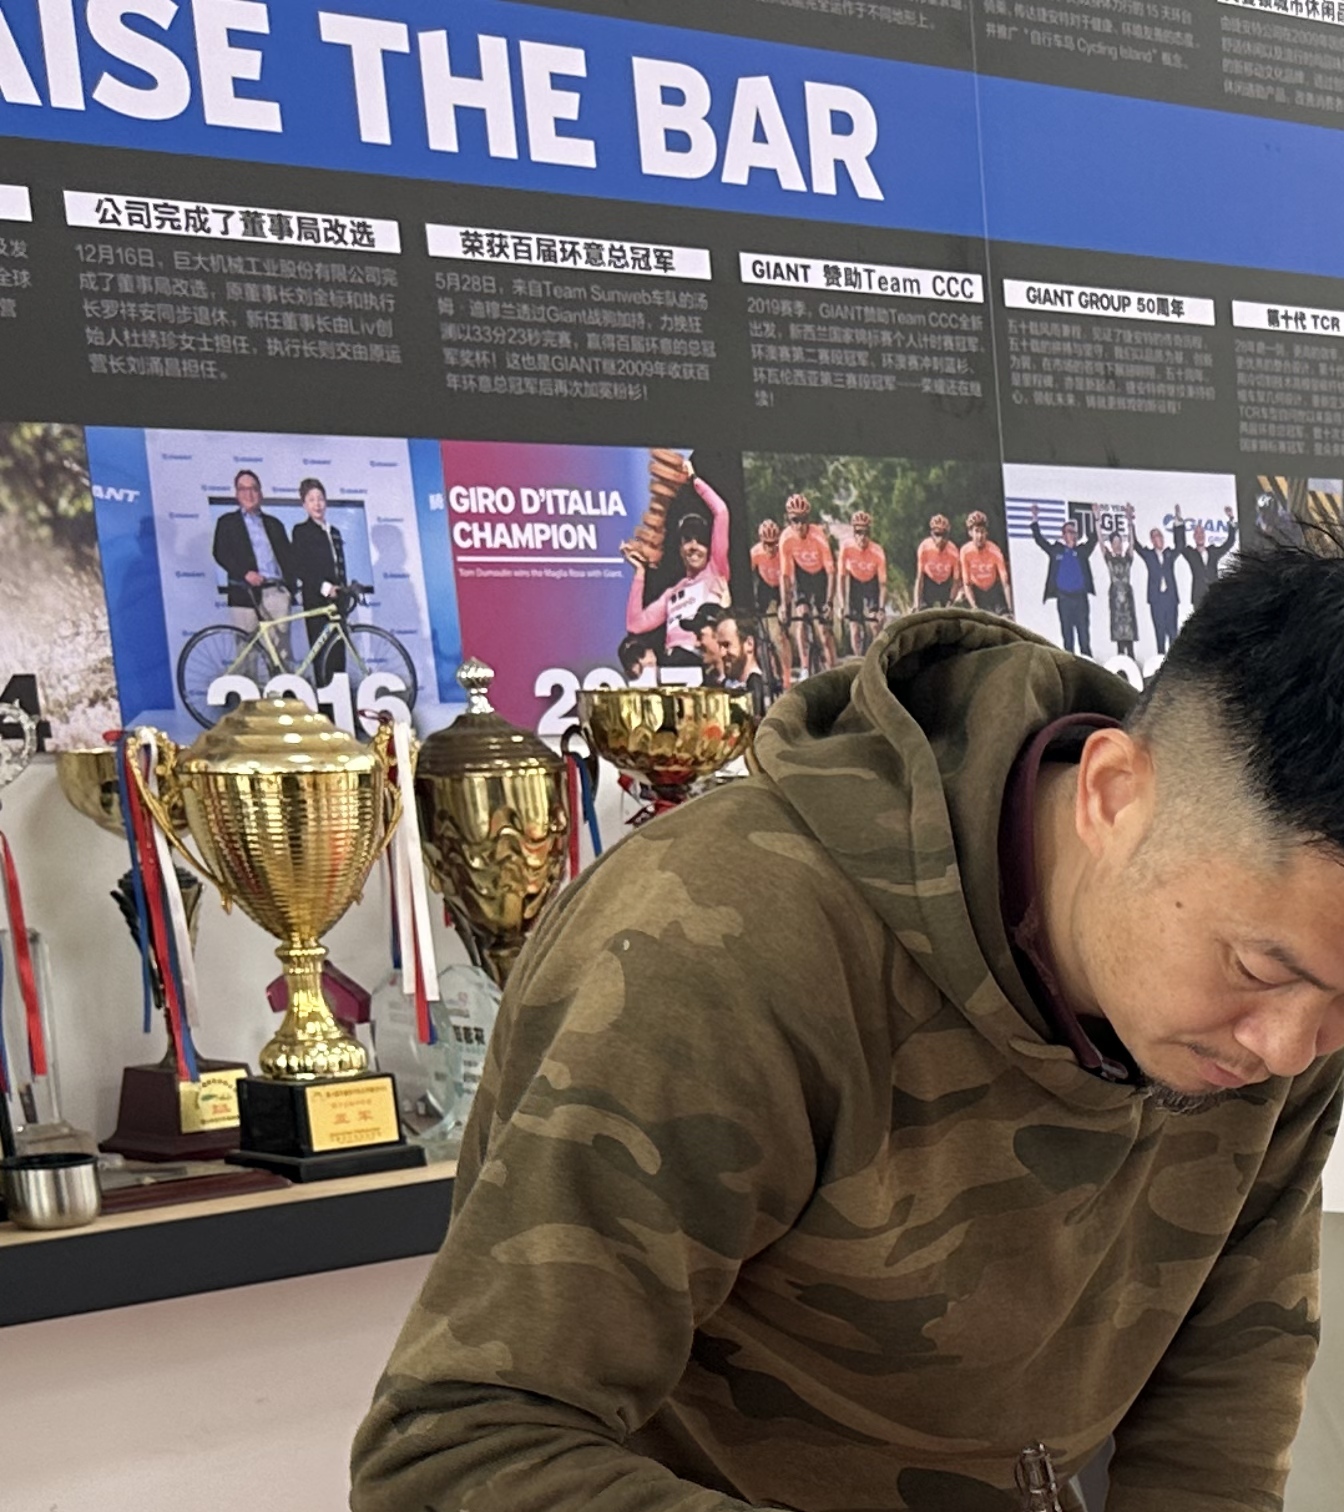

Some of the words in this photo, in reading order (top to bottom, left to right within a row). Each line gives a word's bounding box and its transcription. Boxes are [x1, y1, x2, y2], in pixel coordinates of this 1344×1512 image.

[318, 11, 597, 168] THE
[632, 56, 884, 200] BAR
[95, 197, 376, 248] 公司完成了董事局改选
[460, 230, 676, 273] 荣获百届环意总冠军
[752, 260, 811, 284] GIANT
[823, 264, 921, 295] 赞助Team
[932, 275, 974, 299] CCC
[1026, 286, 1074, 306] GIANT
[1078, 292, 1131, 313] GROUP
[1267, 308, 1307, 331] 第十代
[1311, 314, 1340, 332] TCR
[450, 485, 515, 513] GIRO
[453, 520, 597, 550] CHAMPION
[1184, 516, 1230, 534] GIAN
